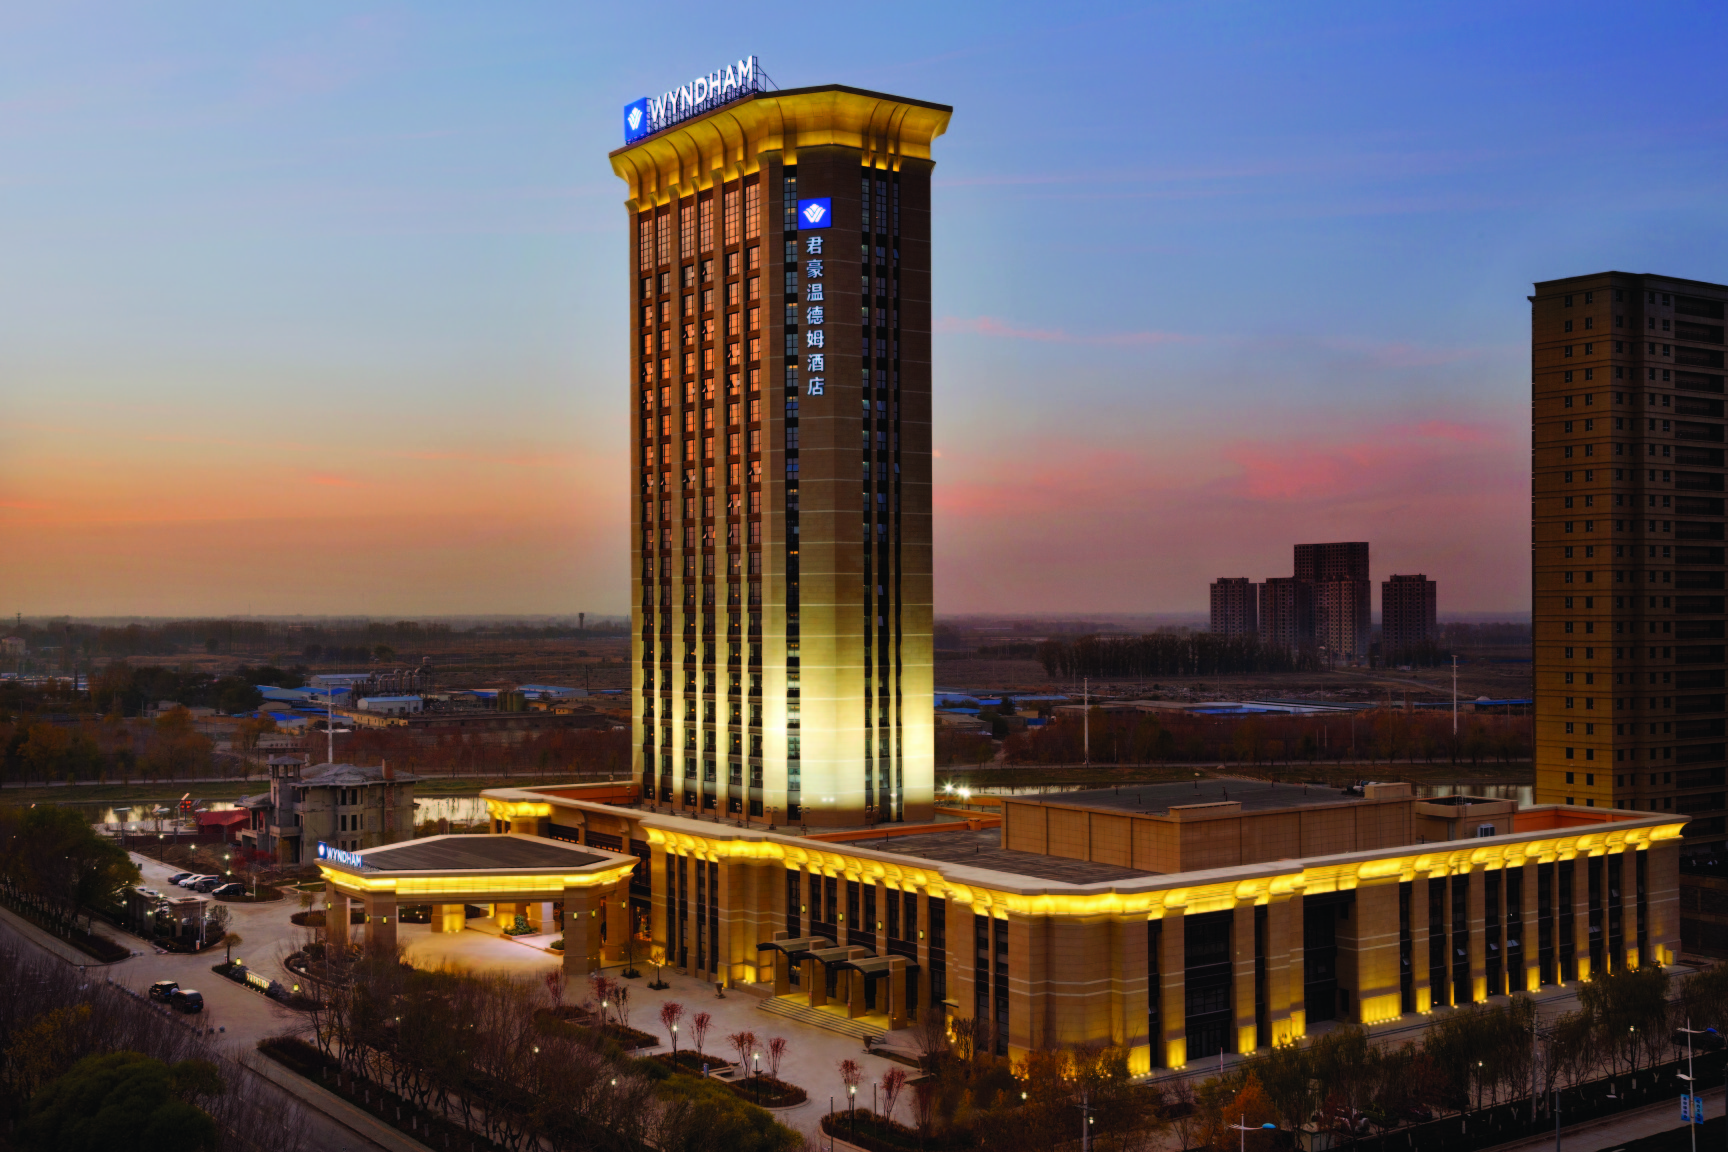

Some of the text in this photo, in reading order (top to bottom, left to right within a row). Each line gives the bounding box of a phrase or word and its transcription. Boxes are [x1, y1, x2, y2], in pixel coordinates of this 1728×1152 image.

[649, 55, 754, 122] WYNDHAM
[806, 236, 825, 396] 君豪温德姆酒店
[326, 846, 363, 867] WYNDHAM
